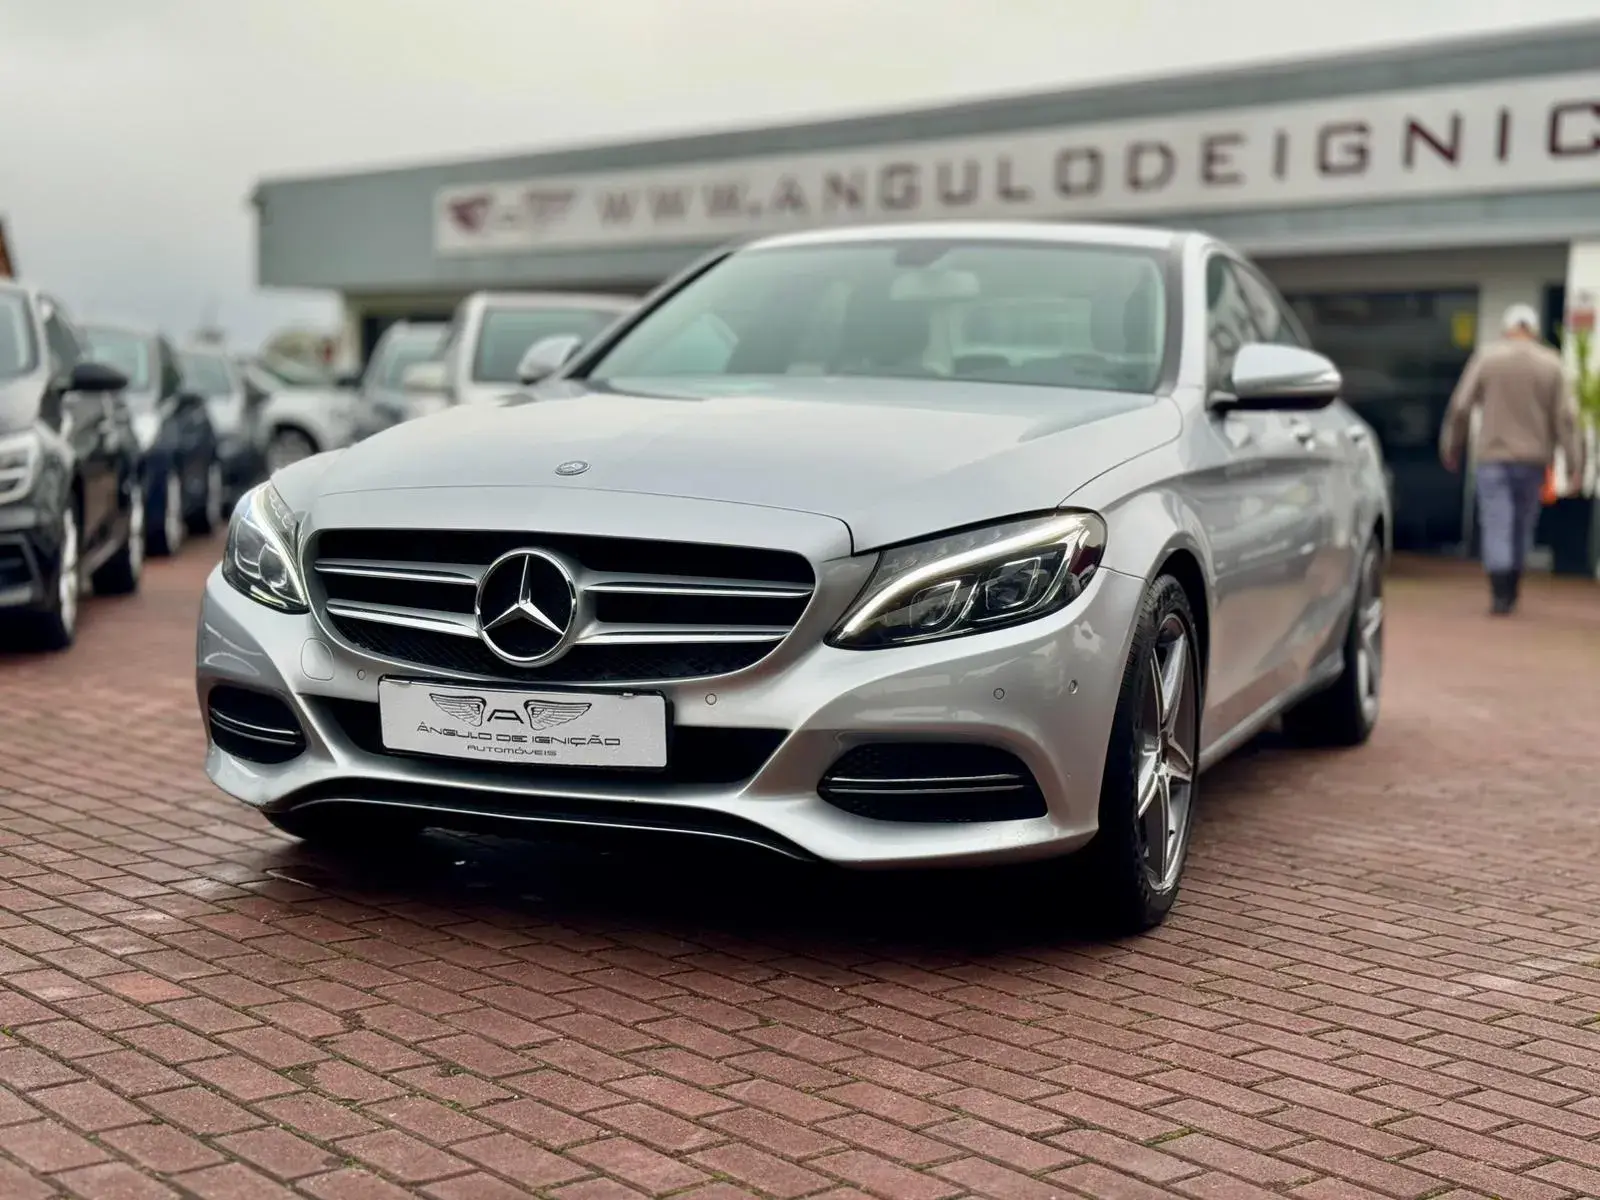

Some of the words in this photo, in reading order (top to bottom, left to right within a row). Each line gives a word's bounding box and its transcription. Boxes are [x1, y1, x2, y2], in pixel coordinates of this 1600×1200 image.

[417, 721, 492, 740] ÂNGULO
[496, 734, 528, 742] DE
[532, 734, 620, 747] IGNIÇÃO
[467, 744, 557, 756] AUTOMÓVEIS
